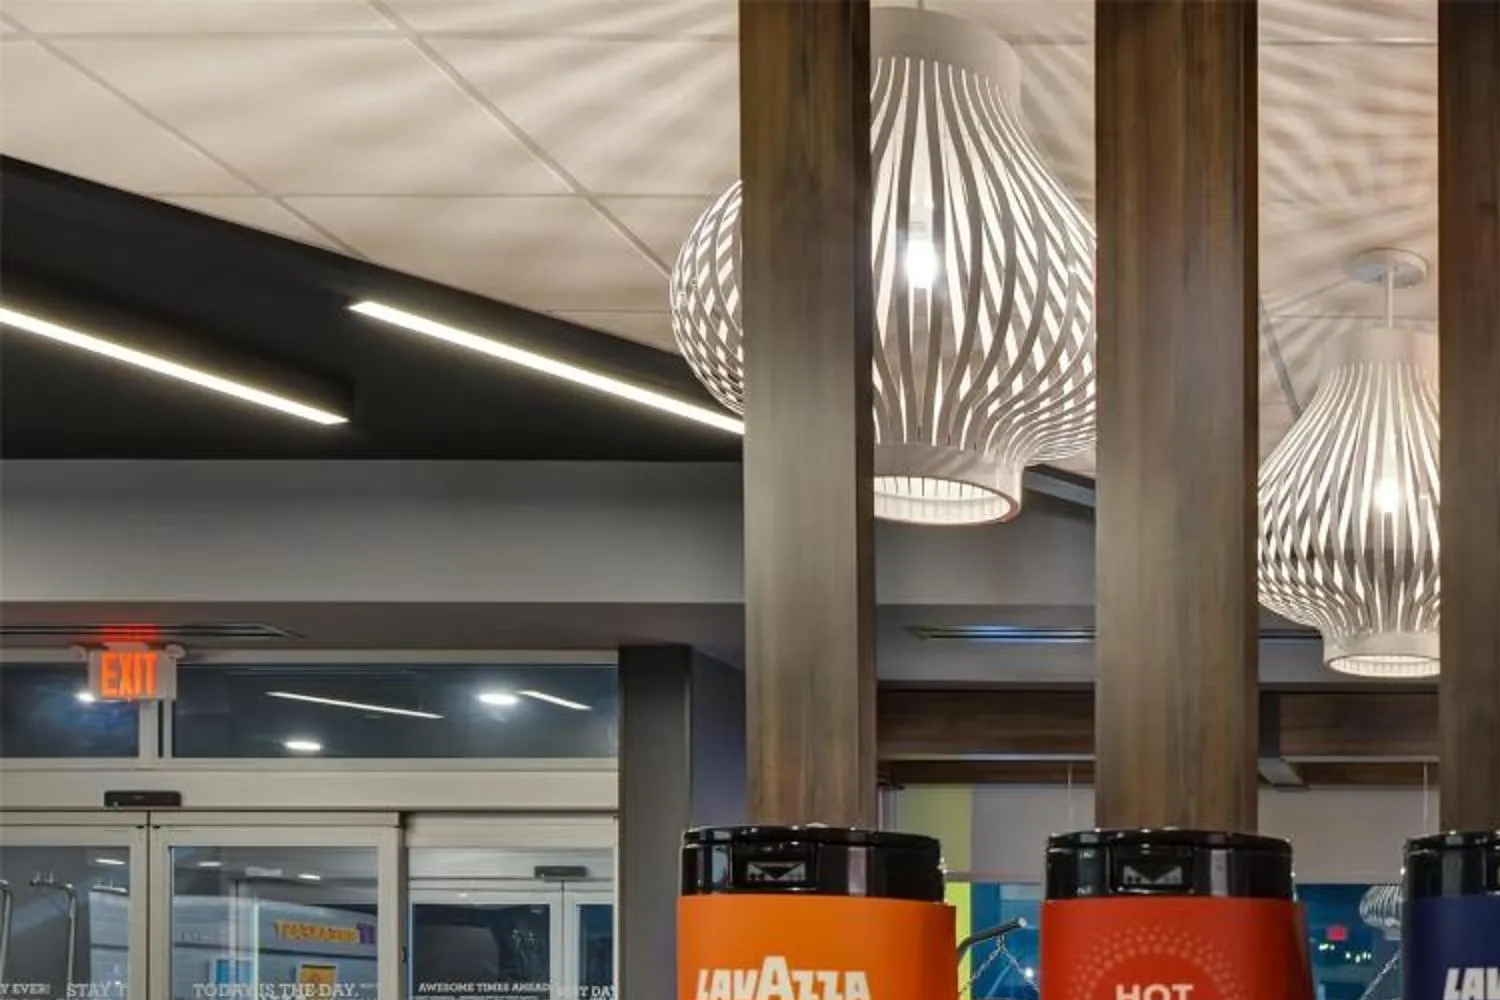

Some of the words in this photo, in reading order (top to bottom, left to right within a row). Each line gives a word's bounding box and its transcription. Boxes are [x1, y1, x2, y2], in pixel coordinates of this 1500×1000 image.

[102, 652, 157, 697] EXIT
[66, 981, 110, 998] STAY
[193, 983, 250, 998] TODAY
[259, 983, 275, 998] IS
[280, 983, 316, 998] THE
[418, 983, 472, 993] AWESOME
[475, 983, 509, 993] TIMES
